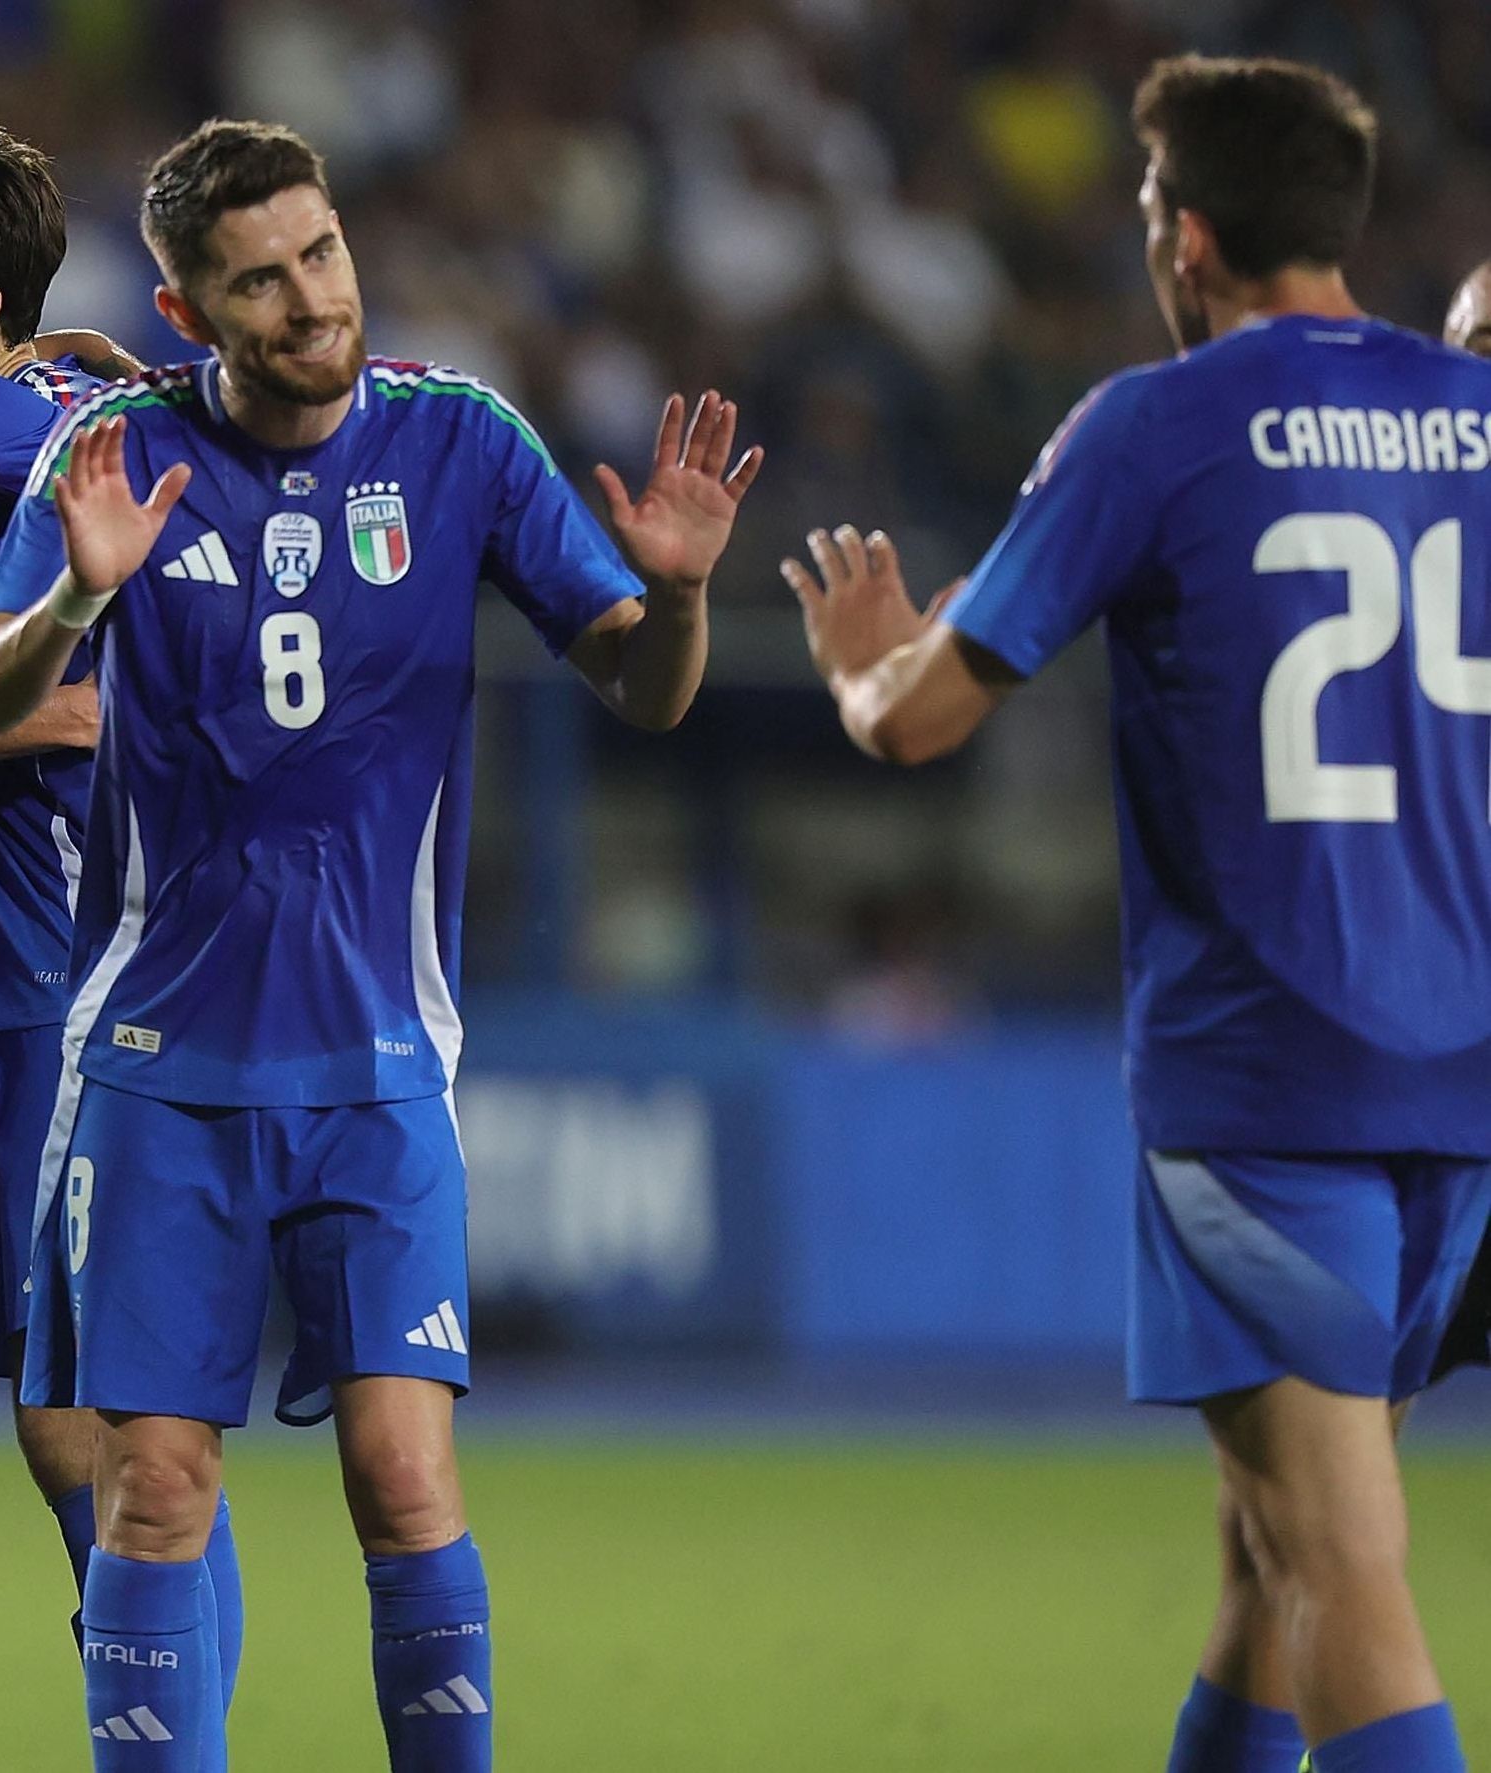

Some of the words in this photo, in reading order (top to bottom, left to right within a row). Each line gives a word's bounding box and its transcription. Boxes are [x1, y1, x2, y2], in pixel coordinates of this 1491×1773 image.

[1248, 404, 1491, 473] CAMBIAS
[353, 503, 400, 524] ITALIA
[259, 611, 326, 731] 8
[68, 1156, 94, 1275] 8
[84, 1642, 179, 1669] ITALIA
